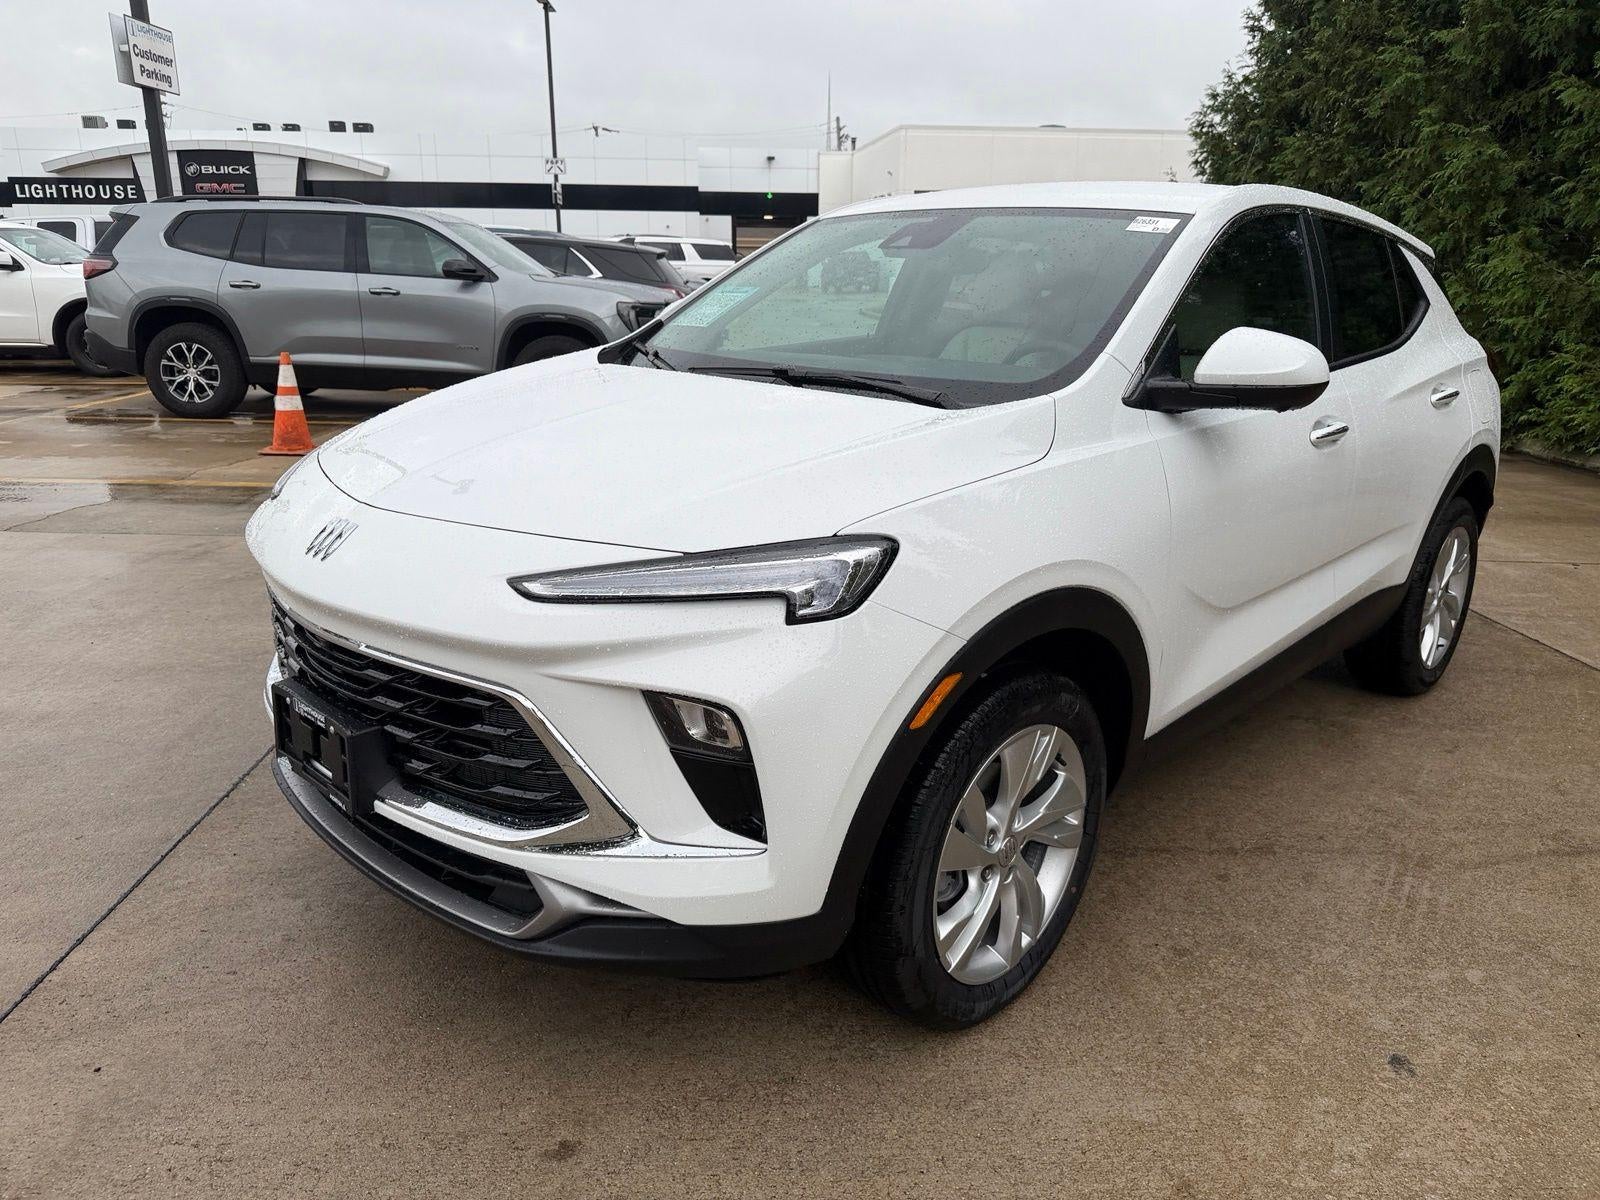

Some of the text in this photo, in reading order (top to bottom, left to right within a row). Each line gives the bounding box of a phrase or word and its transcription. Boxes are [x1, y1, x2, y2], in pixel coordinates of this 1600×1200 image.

[136, 23, 172, 43] LIGHTHOUSE
[133, 43, 173, 67] Customer
[139, 63, 173, 88] Parking
[201, 165, 252, 174] BUICK
[14, 184, 138, 199] LIGHTHOUSE
[194, 182, 246, 193] GMC
